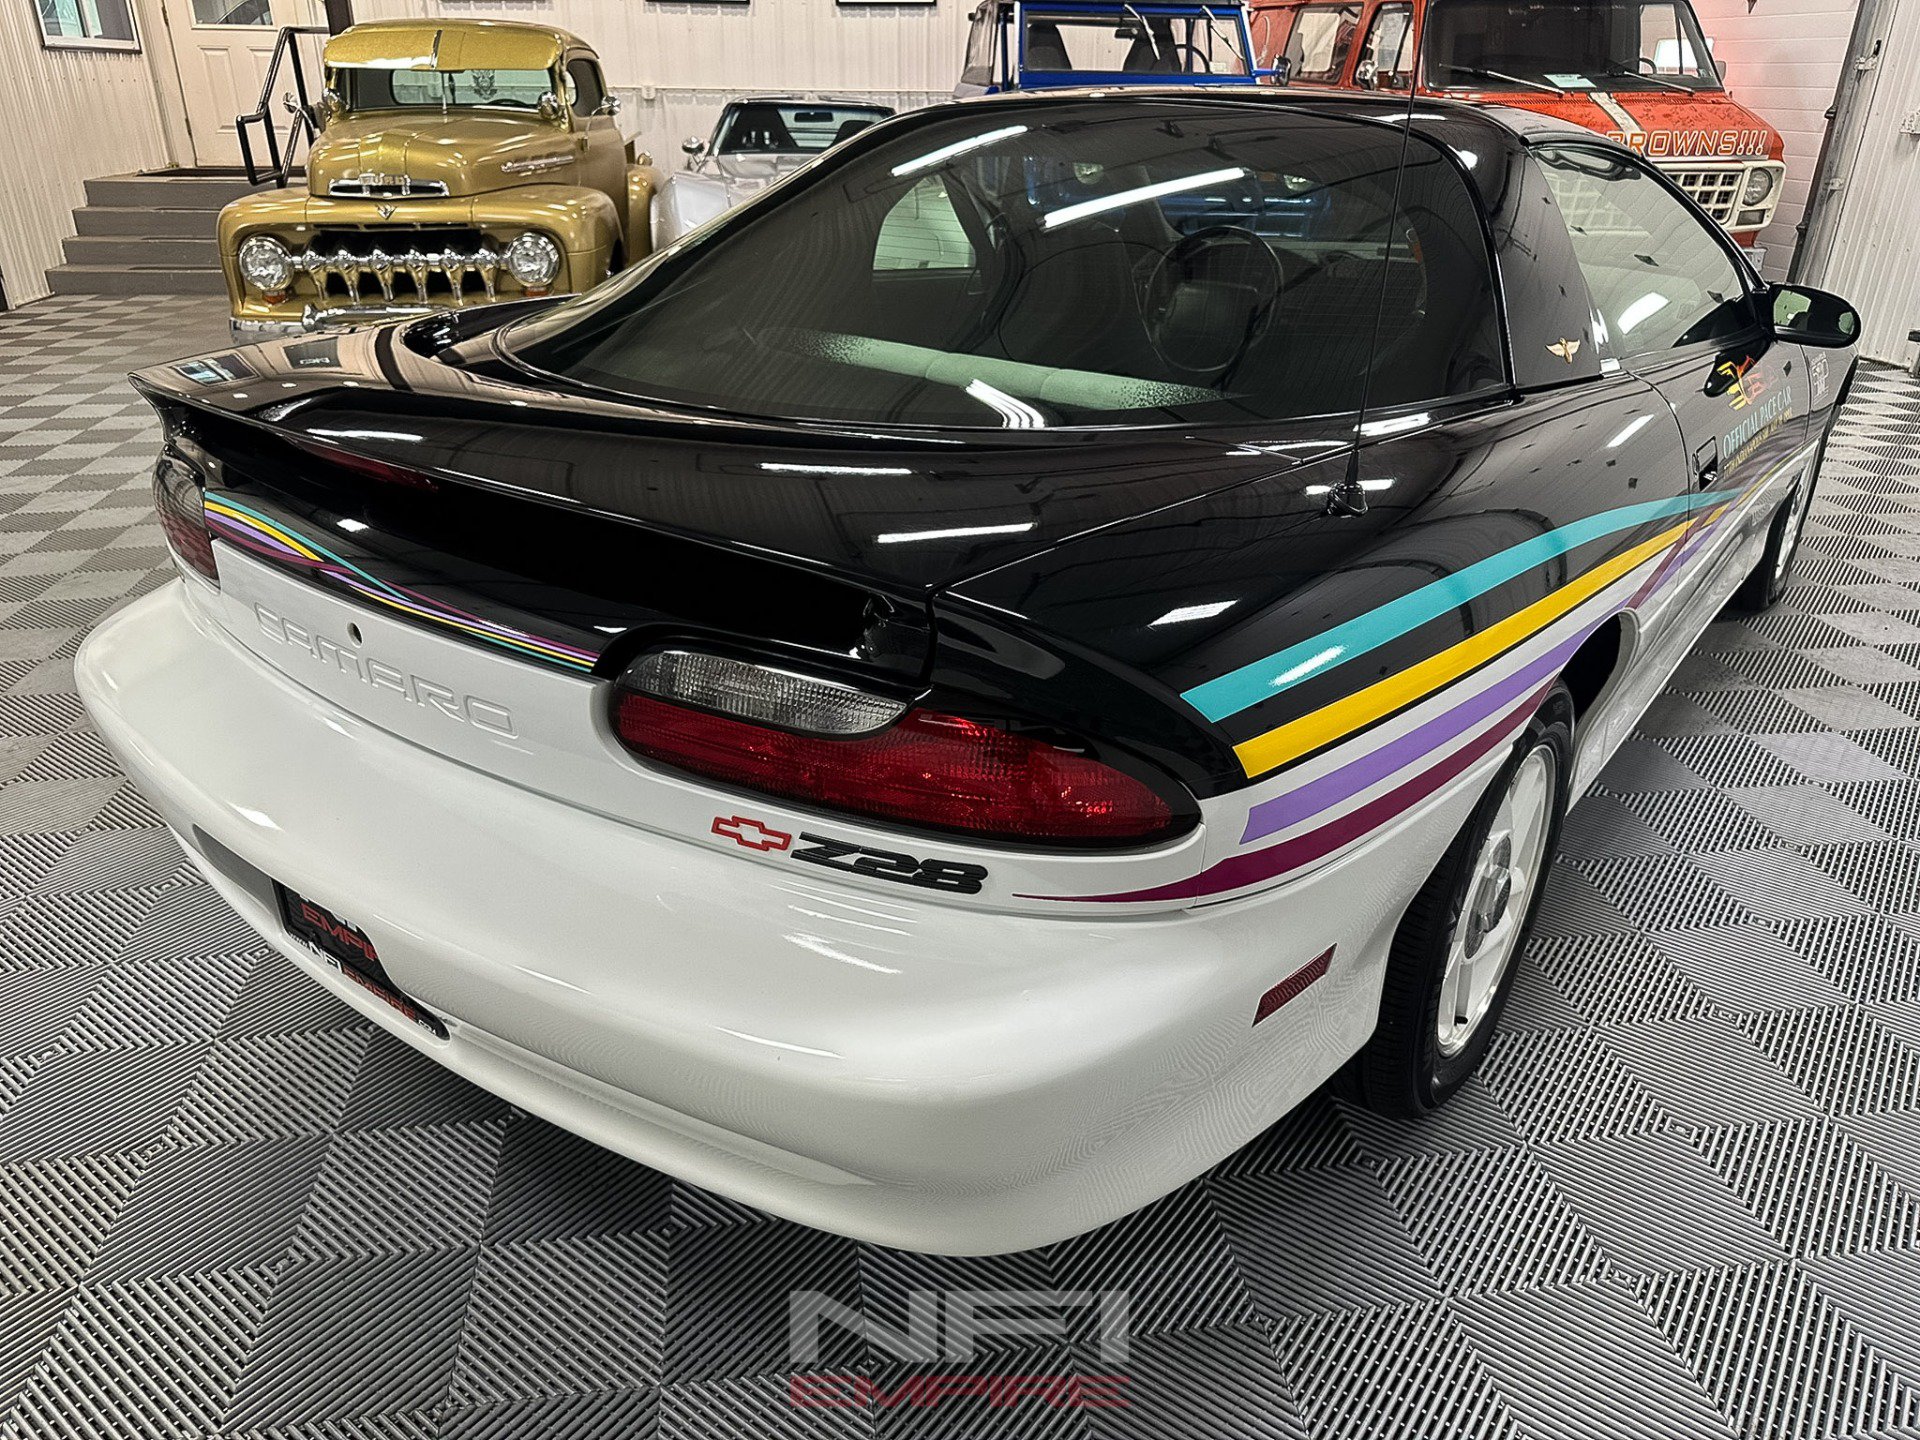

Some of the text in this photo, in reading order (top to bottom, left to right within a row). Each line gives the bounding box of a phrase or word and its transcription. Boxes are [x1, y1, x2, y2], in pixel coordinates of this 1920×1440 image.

[1723, 411, 1760, 459] OFFICIAL
[1760, 396, 1777, 427] PACE
[1777, 386, 1792, 411] CAR
[254, 601, 519, 739] CAMARO
[790, 831, 989, 895] Z28
